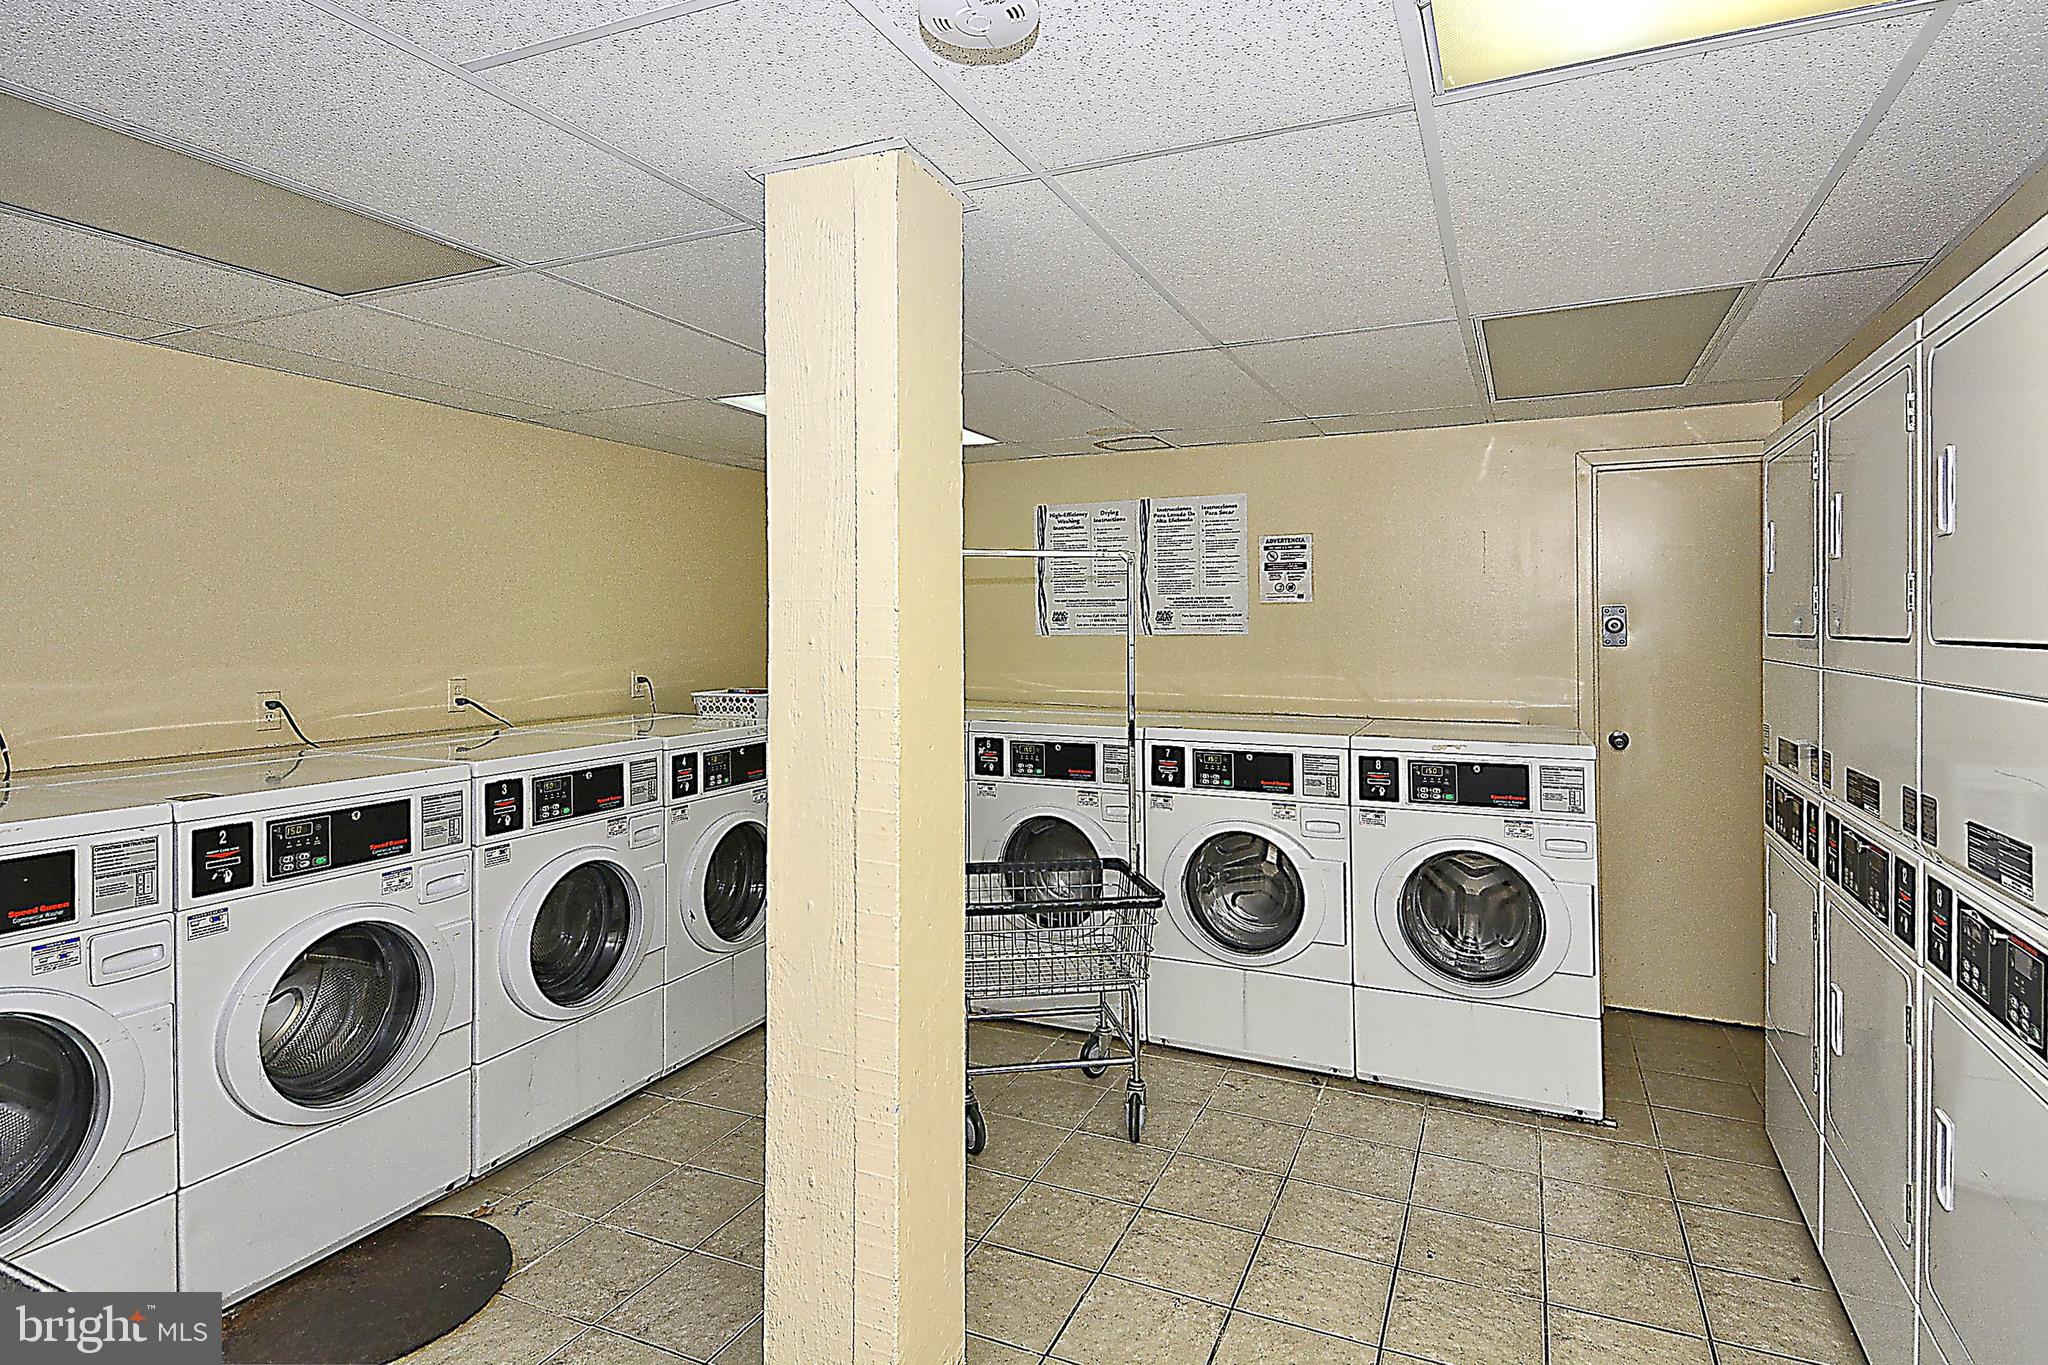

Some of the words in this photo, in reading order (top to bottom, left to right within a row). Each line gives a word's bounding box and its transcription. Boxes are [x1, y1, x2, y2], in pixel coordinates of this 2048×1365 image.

[1049, 511, 1088, 519] High-Efficiency
[986, 740, 991, 748] 6
[1166, 748, 1170, 758] 7
[1375, 760, 1381, 770] 8
[501, 784, 508, 794] 3
[219, 830, 227, 844] 2
[95, 843, 122, 852] OPERATING
[122, 839, 156, 848] INSTRUCTIONS
[8, 906, 38, 918] Speed
[40, 902, 70, 912] Queen
[12, 914, 44, 924] Commercial
